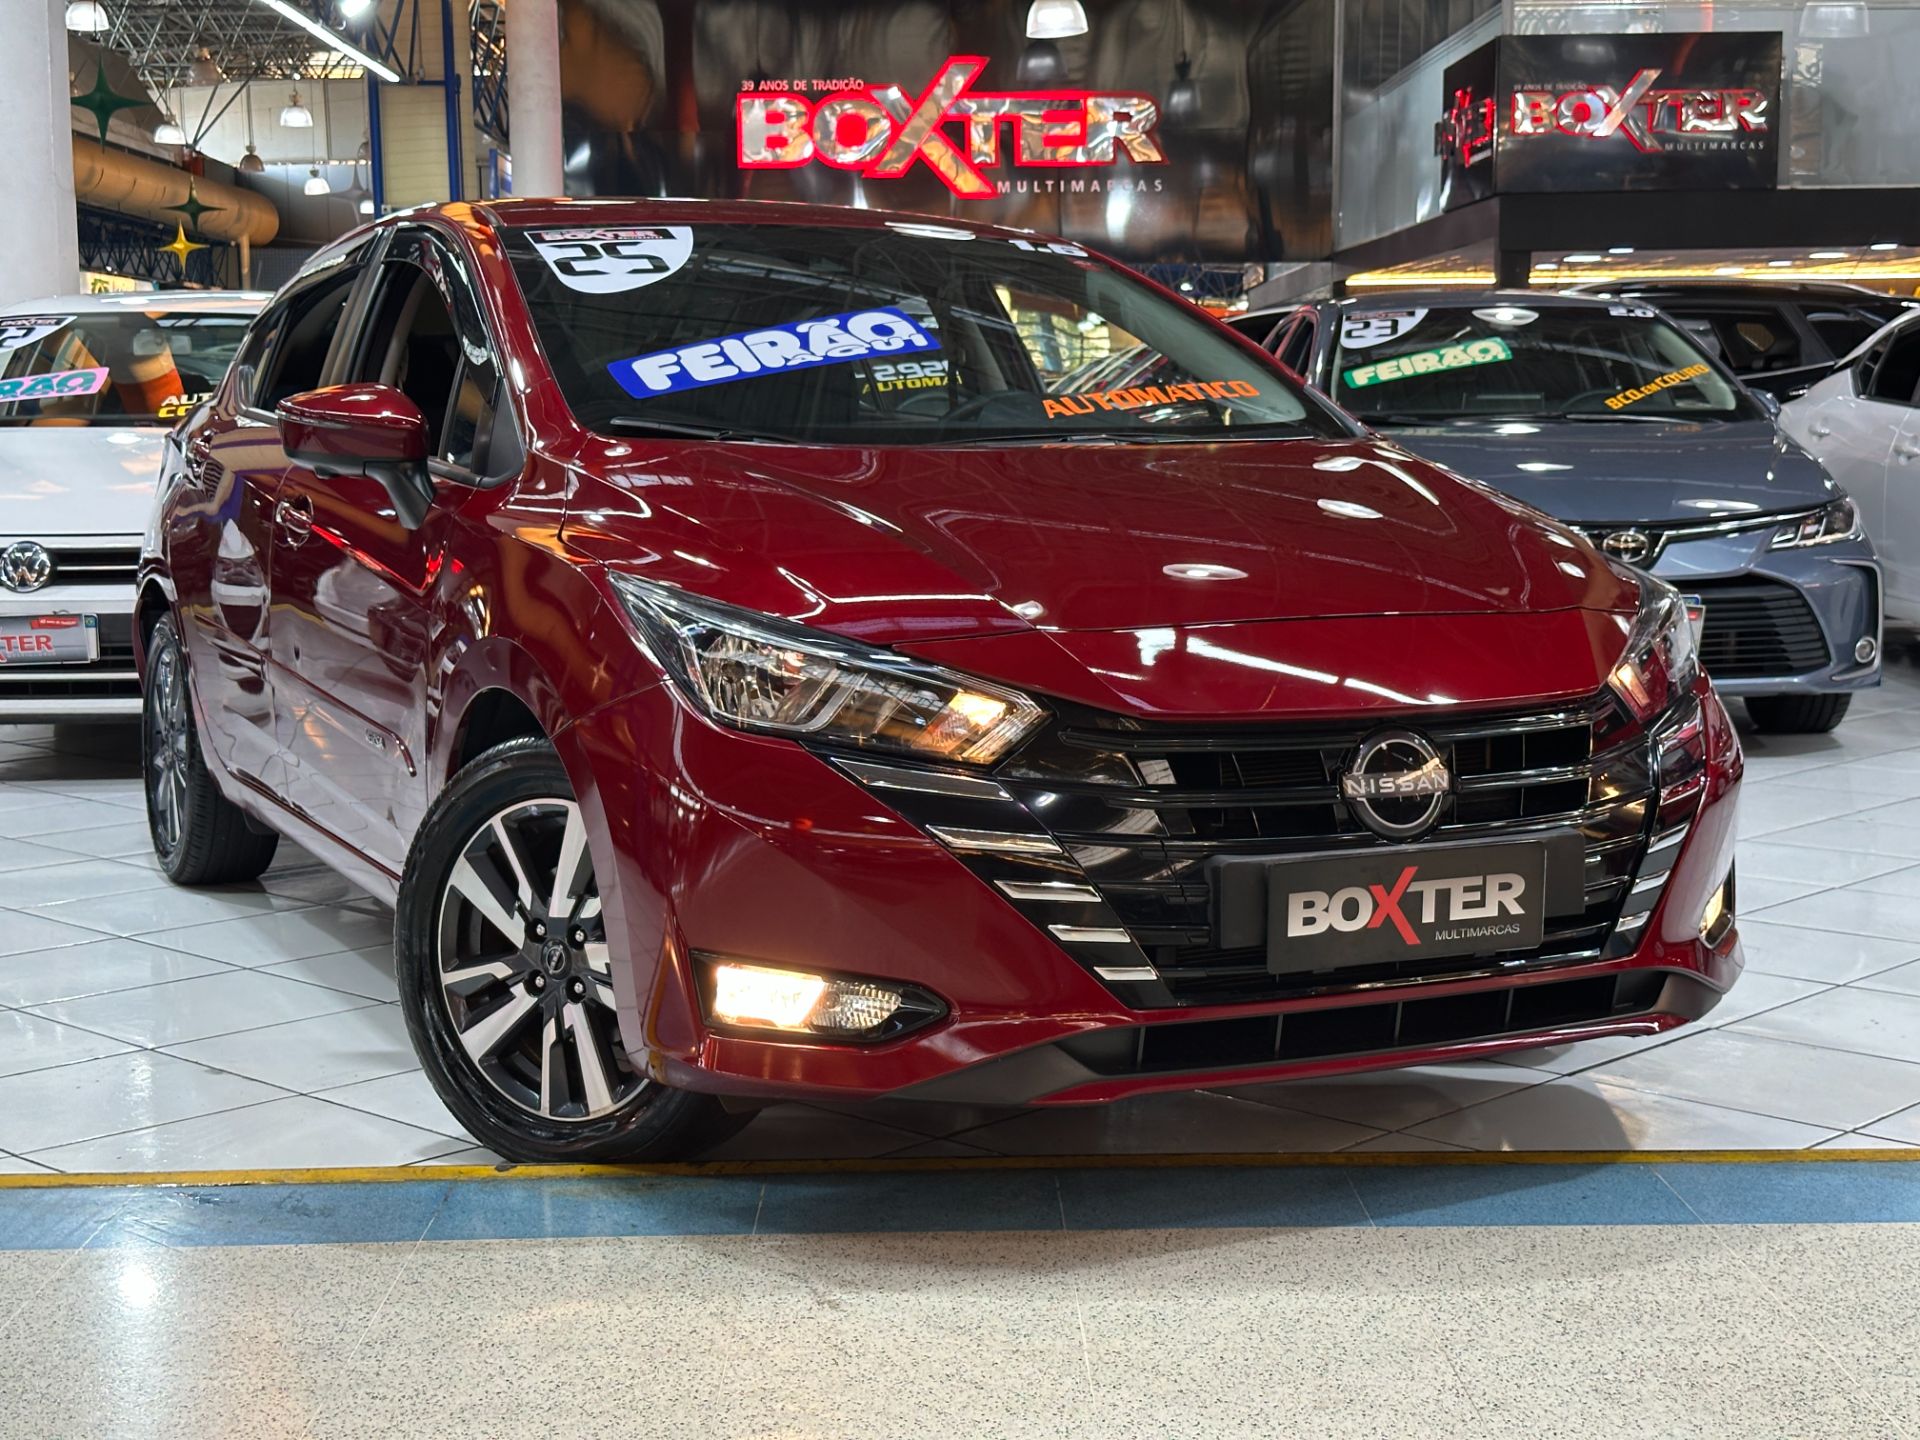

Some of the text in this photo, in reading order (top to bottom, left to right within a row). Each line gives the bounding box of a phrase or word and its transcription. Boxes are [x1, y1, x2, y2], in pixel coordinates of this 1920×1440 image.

[741, 77, 865, 91] 39 ANOS DE TRADIÇÃO
[737, 55, 1170, 199] BOXTER
[1511, 68, 1769, 153] BOXTER
[1665, 142, 1764, 151] MULTIMARCAS
[998, 179, 1163, 194] MULTIMARCAS
[546, 241, 671, 276] 25
[1345, 318, 1399, 339] 23
[632, 312, 919, 390] FEIRÃO
[1352, 340, 1506, 385] FEIRÃO
[1042, 381, 1260, 419] AUTOMATICO
[1346, 775, 1449, 794] NISSAN
[1287, 866, 1526, 945] BOXTER
[1435, 923, 1521, 941] MULTIMARCAS
